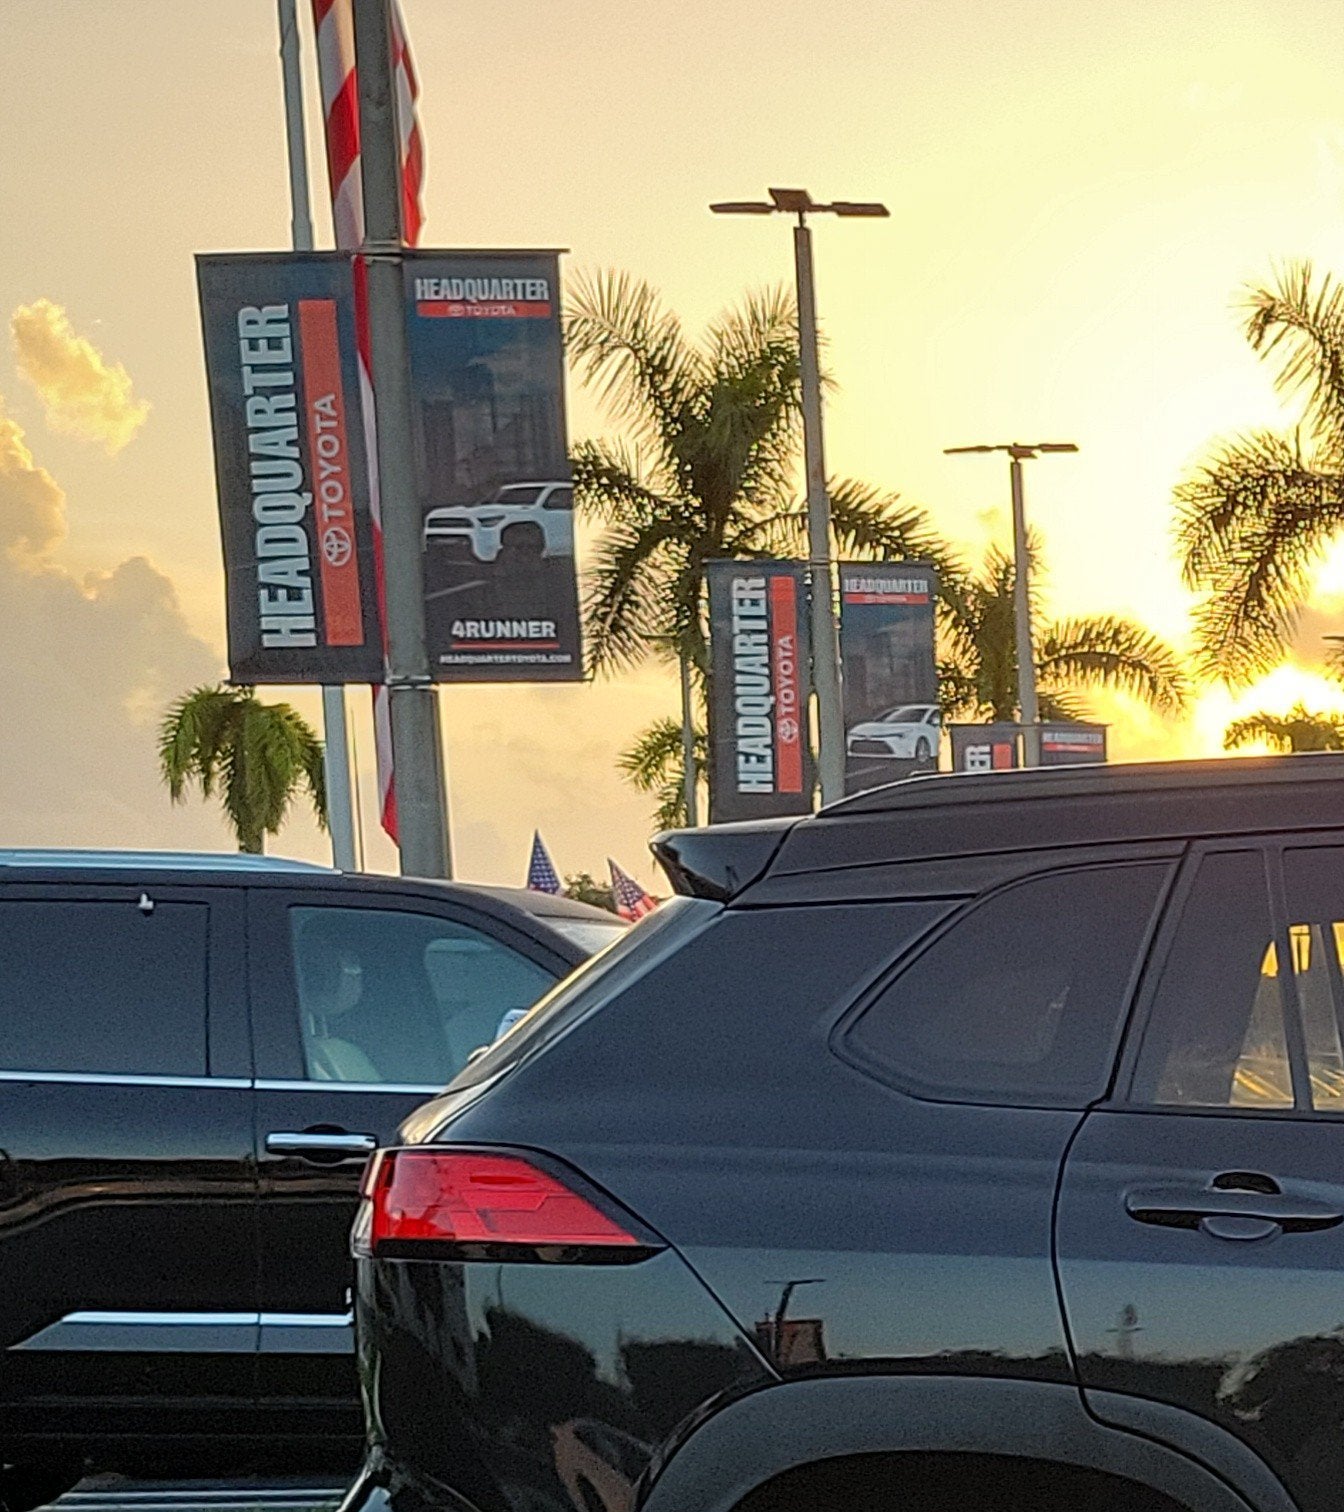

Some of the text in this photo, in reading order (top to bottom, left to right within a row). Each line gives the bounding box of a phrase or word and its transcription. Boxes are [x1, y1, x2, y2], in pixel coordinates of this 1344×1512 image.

[415, 277, 549, 302] HEADQUARTER
[466, 304, 516, 316] TOYOTA
[238, 303, 316, 648] HEADQUARTER
[315, 393, 346, 523] TOYOTA
[451, 620, 556, 638] 4RUNNER
[733, 577, 776, 793] HEADQUARTER
[777, 635, 796, 715] TOYOTA
